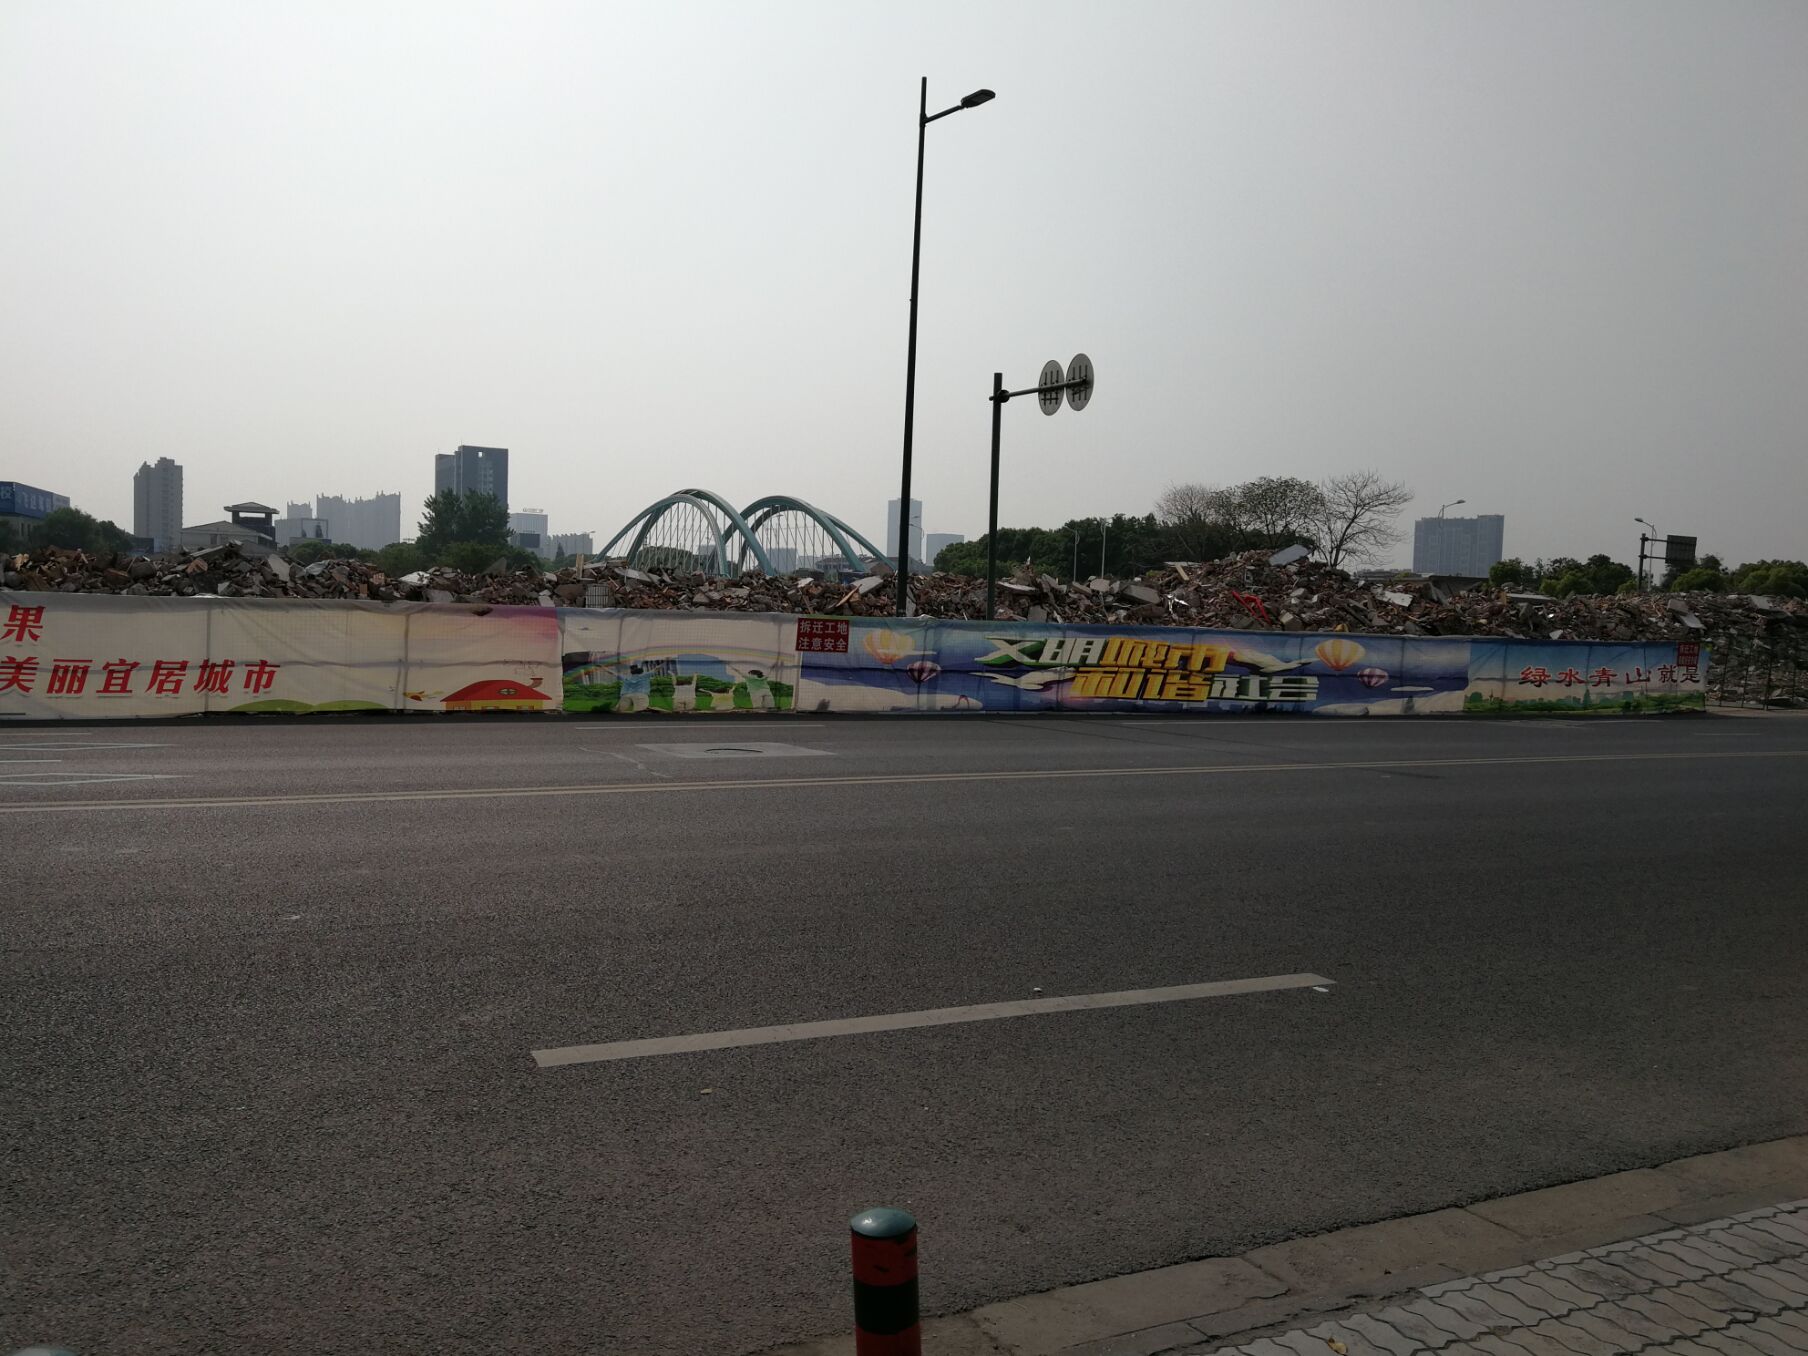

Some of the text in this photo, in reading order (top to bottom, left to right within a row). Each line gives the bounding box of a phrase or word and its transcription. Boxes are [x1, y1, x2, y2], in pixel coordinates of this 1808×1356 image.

[0, 605, 46, 642] 果
[800, 621, 848, 635] 拆迁工地
[799, 637, 847, 651] 注意安全
[975, 637, 1229, 673] 文明城市
[0, 656, 281, 694] 美丽宜居城市
[1070, 667, 1320, 701] 和谐社会
[1519, 664, 1700, 687] 绿水青山就是
